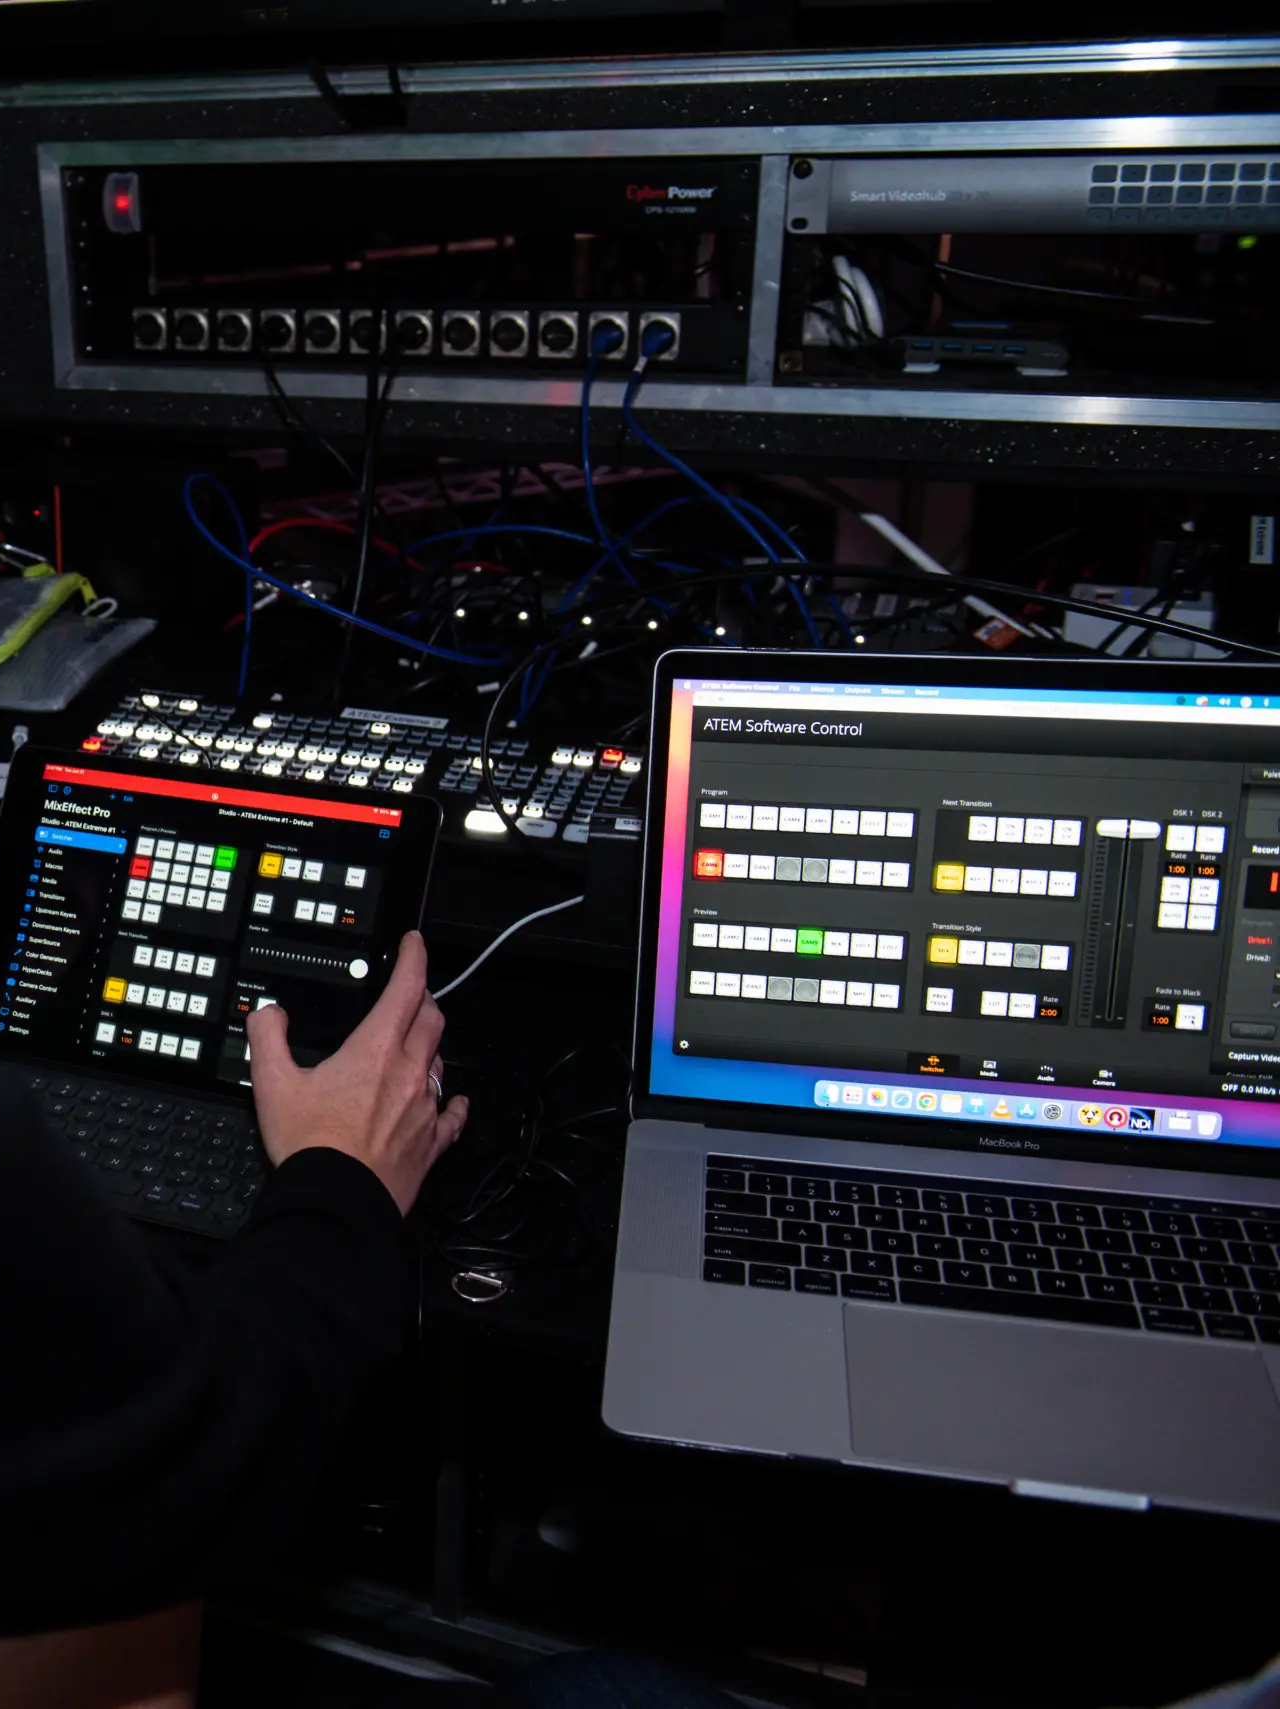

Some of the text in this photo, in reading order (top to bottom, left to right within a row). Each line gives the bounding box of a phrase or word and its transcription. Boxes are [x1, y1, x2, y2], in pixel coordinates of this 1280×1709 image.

[850, 190, 886, 202] Smart
[888, 189, 947, 202] Videohub
[753, 684, 780, 692] Control
[844, 687, 871, 695] Outputs
[348, 710, 382, 719] ATEM
[384, 714, 430, 725] Extreme
[704, 718, 863, 736] ATEM Software Control
[701, 788, 728, 797] Program
[44, 799, 111, 818] MixEffect Pro
[959, 799, 992, 808] Transition
[218, 808, 237, 817] Studio
[240, 812, 257, 820] ATEM
[258, 814, 281, 824] Extreme
[292, 819, 314, 828] Default
[1202, 810, 1217, 818] DSK
[41, 817, 61, 826] Studio
[64, 820, 82, 829] ATEM
[82, 823, 107, 833] Extreme
[1252, 844, 1280, 855] Record
[1171, 852, 1187, 860] Rate
[44, 862, 64, 871] Macros
[1168, 865, 1186, 874] 1:00
[1197, 866, 1215, 876] 1:00
[42, 876, 58, 885] Media
[39, 891, 66, 902] Transitions
[35, 906, 77, 920] Upstream Keyers
[694, 908, 718, 916] Preview
[342, 916, 355, 924] 2:00
[32, 921, 81, 936] Downstream Keyers
[932, 922, 982, 933] Transition Style
[28, 936, 61, 947] SuperSource
[1248, 935, 1272, 945] Drive1:
[26, 950, 68, 964] Color Generators
[1246, 953, 1271, 962] Drive2:
[22, 966, 52, 976] HyperDecks
[18, 980, 58, 993] Camera Control
[1156, 986, 1172, 995] Fade
[1182, 988, 1202, 997] Black
[16, 996, 36, 1006] Auxiliary
[1043, 995, 1059, 1003] Rate
[237, 1004, 250, 1012] 1:00
[1154, 1003, 1170, 1011] Rate
[12, 1010, 30, 1020] Output
[1040, 1008, 1058, 1017] 2:00
[1152, 1016, 1169, 1025] 1:00
[8, 1025, 30, 1036] Settings
[121, 1036, 132, 1044] 1:00
[1228, 1051, 1260, 1062] Capture
[920, 1065, 945, 1074] Switcher
[980, 1070, 998, 1078] Media
[1037, 1074, 1055, 1082] Audio
[1092, 1079, 1116, 1087] Camera
[1221, 1083, 1277, 1096] OFF 0.0 Mb/s
[1130, 1118, 1151, 1130] NDI
[979, 1137, 1040, 1151] MacBook Pro
